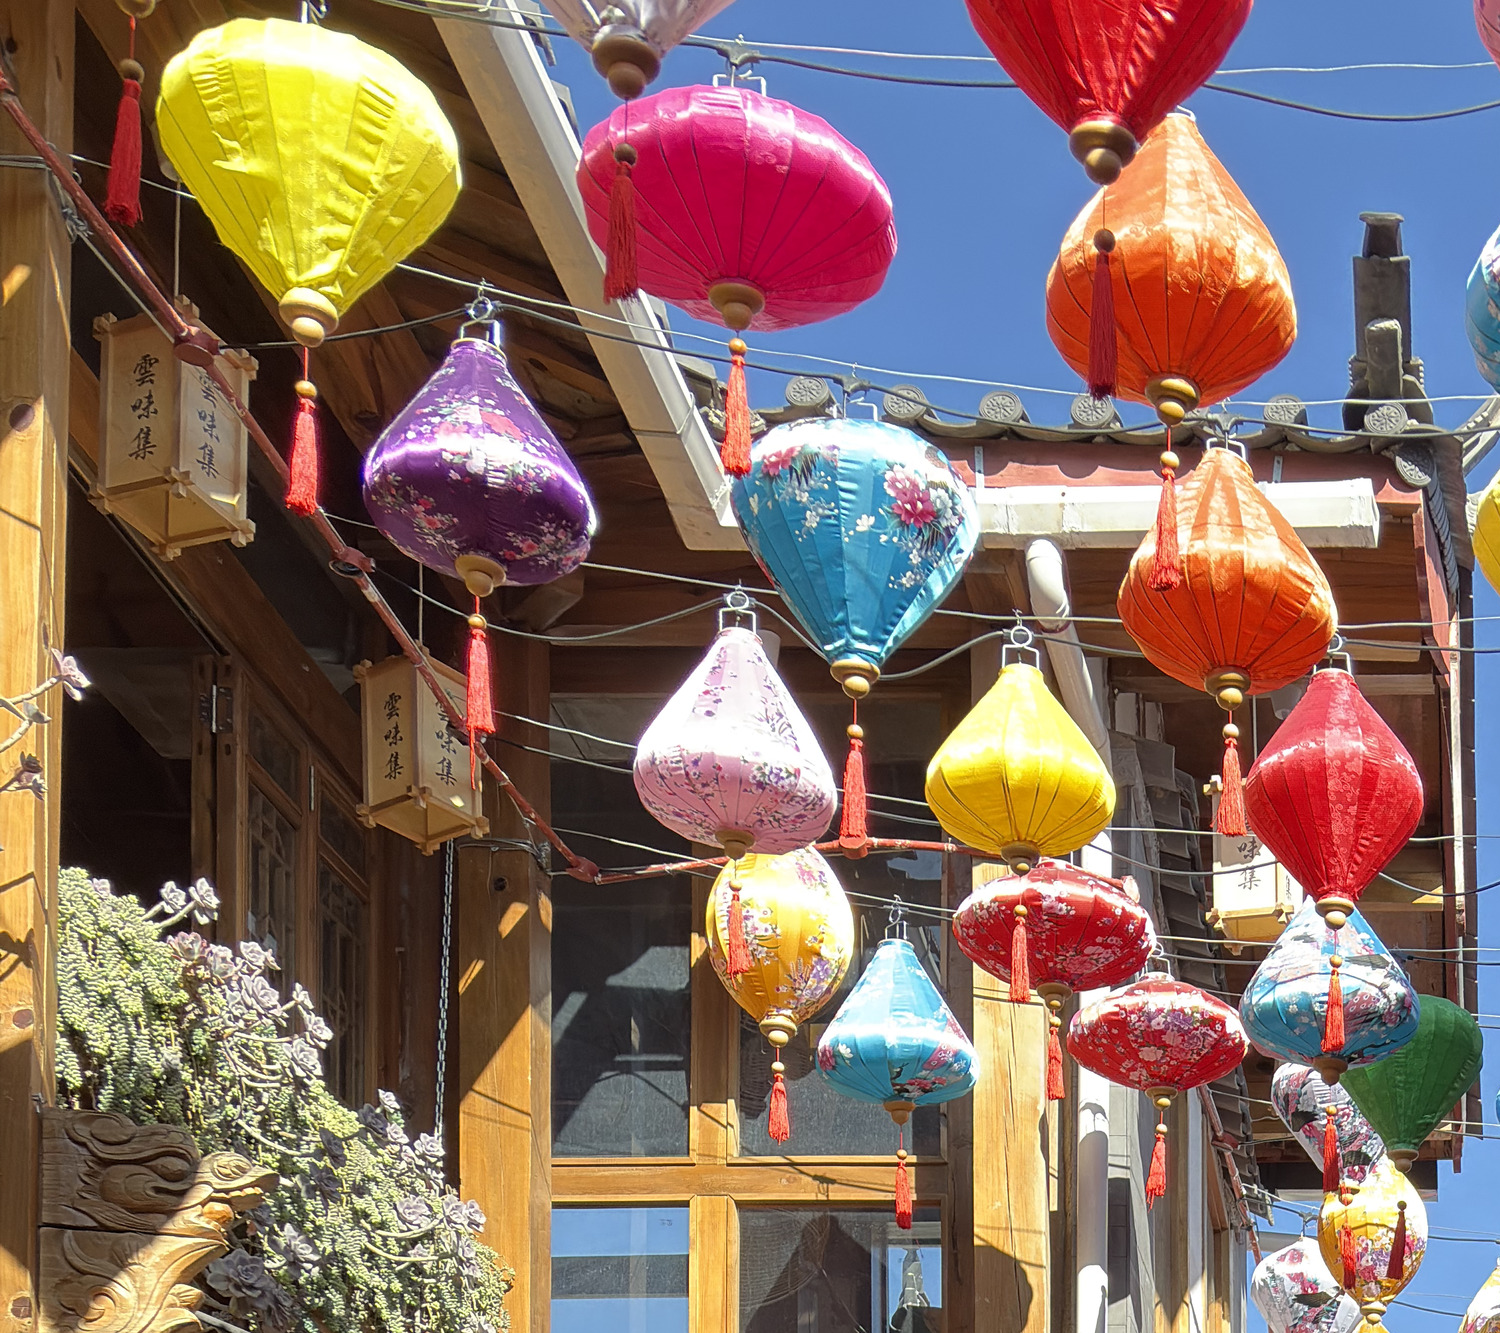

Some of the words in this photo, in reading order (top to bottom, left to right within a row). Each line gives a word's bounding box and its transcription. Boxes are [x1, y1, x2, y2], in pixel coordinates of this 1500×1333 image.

[128, 353, 160, 461] 雲味集
[384, 691, 404, 781] 雲味集
